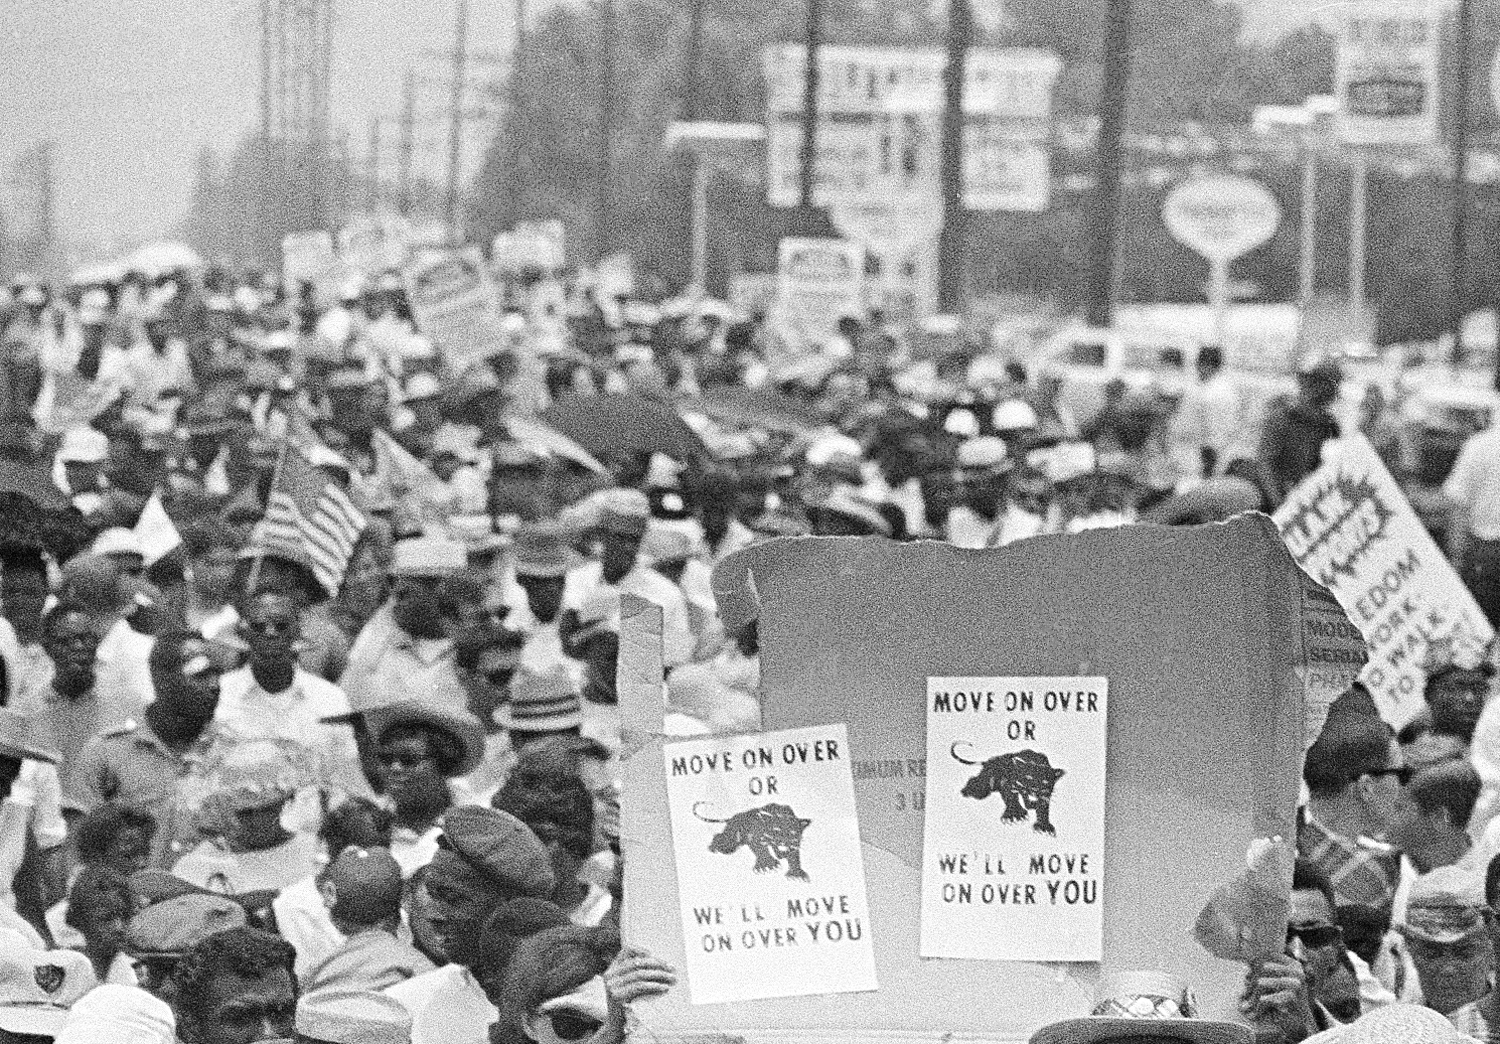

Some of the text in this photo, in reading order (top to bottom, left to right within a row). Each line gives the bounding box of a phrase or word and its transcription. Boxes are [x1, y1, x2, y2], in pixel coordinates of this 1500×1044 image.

[934, 691, 1098, 712] MOVE ON OVER
[1007, 720, 1036, 740] OR
[671, 740, 840, 776] MOVE ON OVER
[749, 775, 779, 795] OR
[1029, 853, 1089, 875] MOVE
[942, 879, 1097, 905] ON OVER YOU
[787, 895, 850, 919] MOVE
[703, 918, 862, 953] ON OVER YOU
